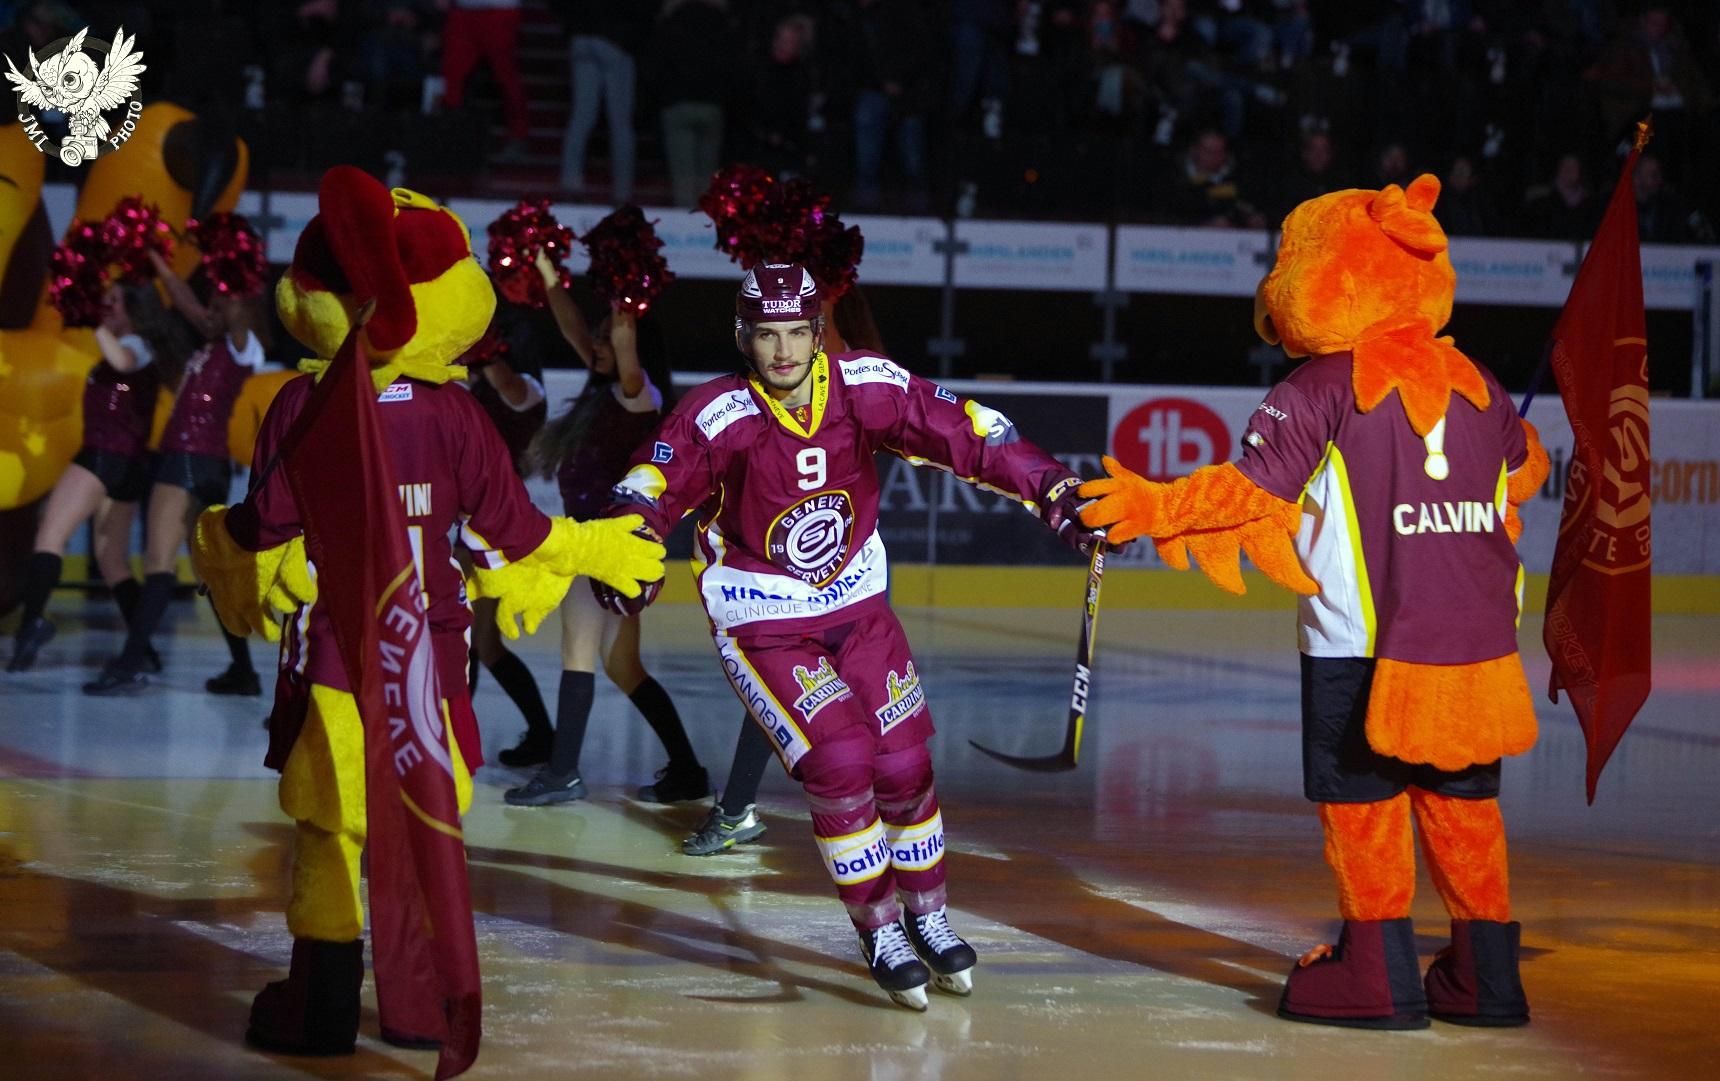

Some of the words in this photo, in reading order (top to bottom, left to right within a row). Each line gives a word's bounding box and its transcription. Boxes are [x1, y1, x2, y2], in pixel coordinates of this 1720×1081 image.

[762, 300, 801, 308] TUDOR
[844, 365, 871, 376] Portes
[872, 364, 884, 373] du
[701, 408, 726, 431] Portes
[725, 401, 737, 412] du
[795, 447, 827, 491] 9
[781, 496, 846, 529] GENEVE
[1393, 501, 1495, 535] CALVIN
[771, 543, 785, 554] 19
[725, 602, 804, 622] CLINIQUE
[1072, 663, 1092, 716] CCM
